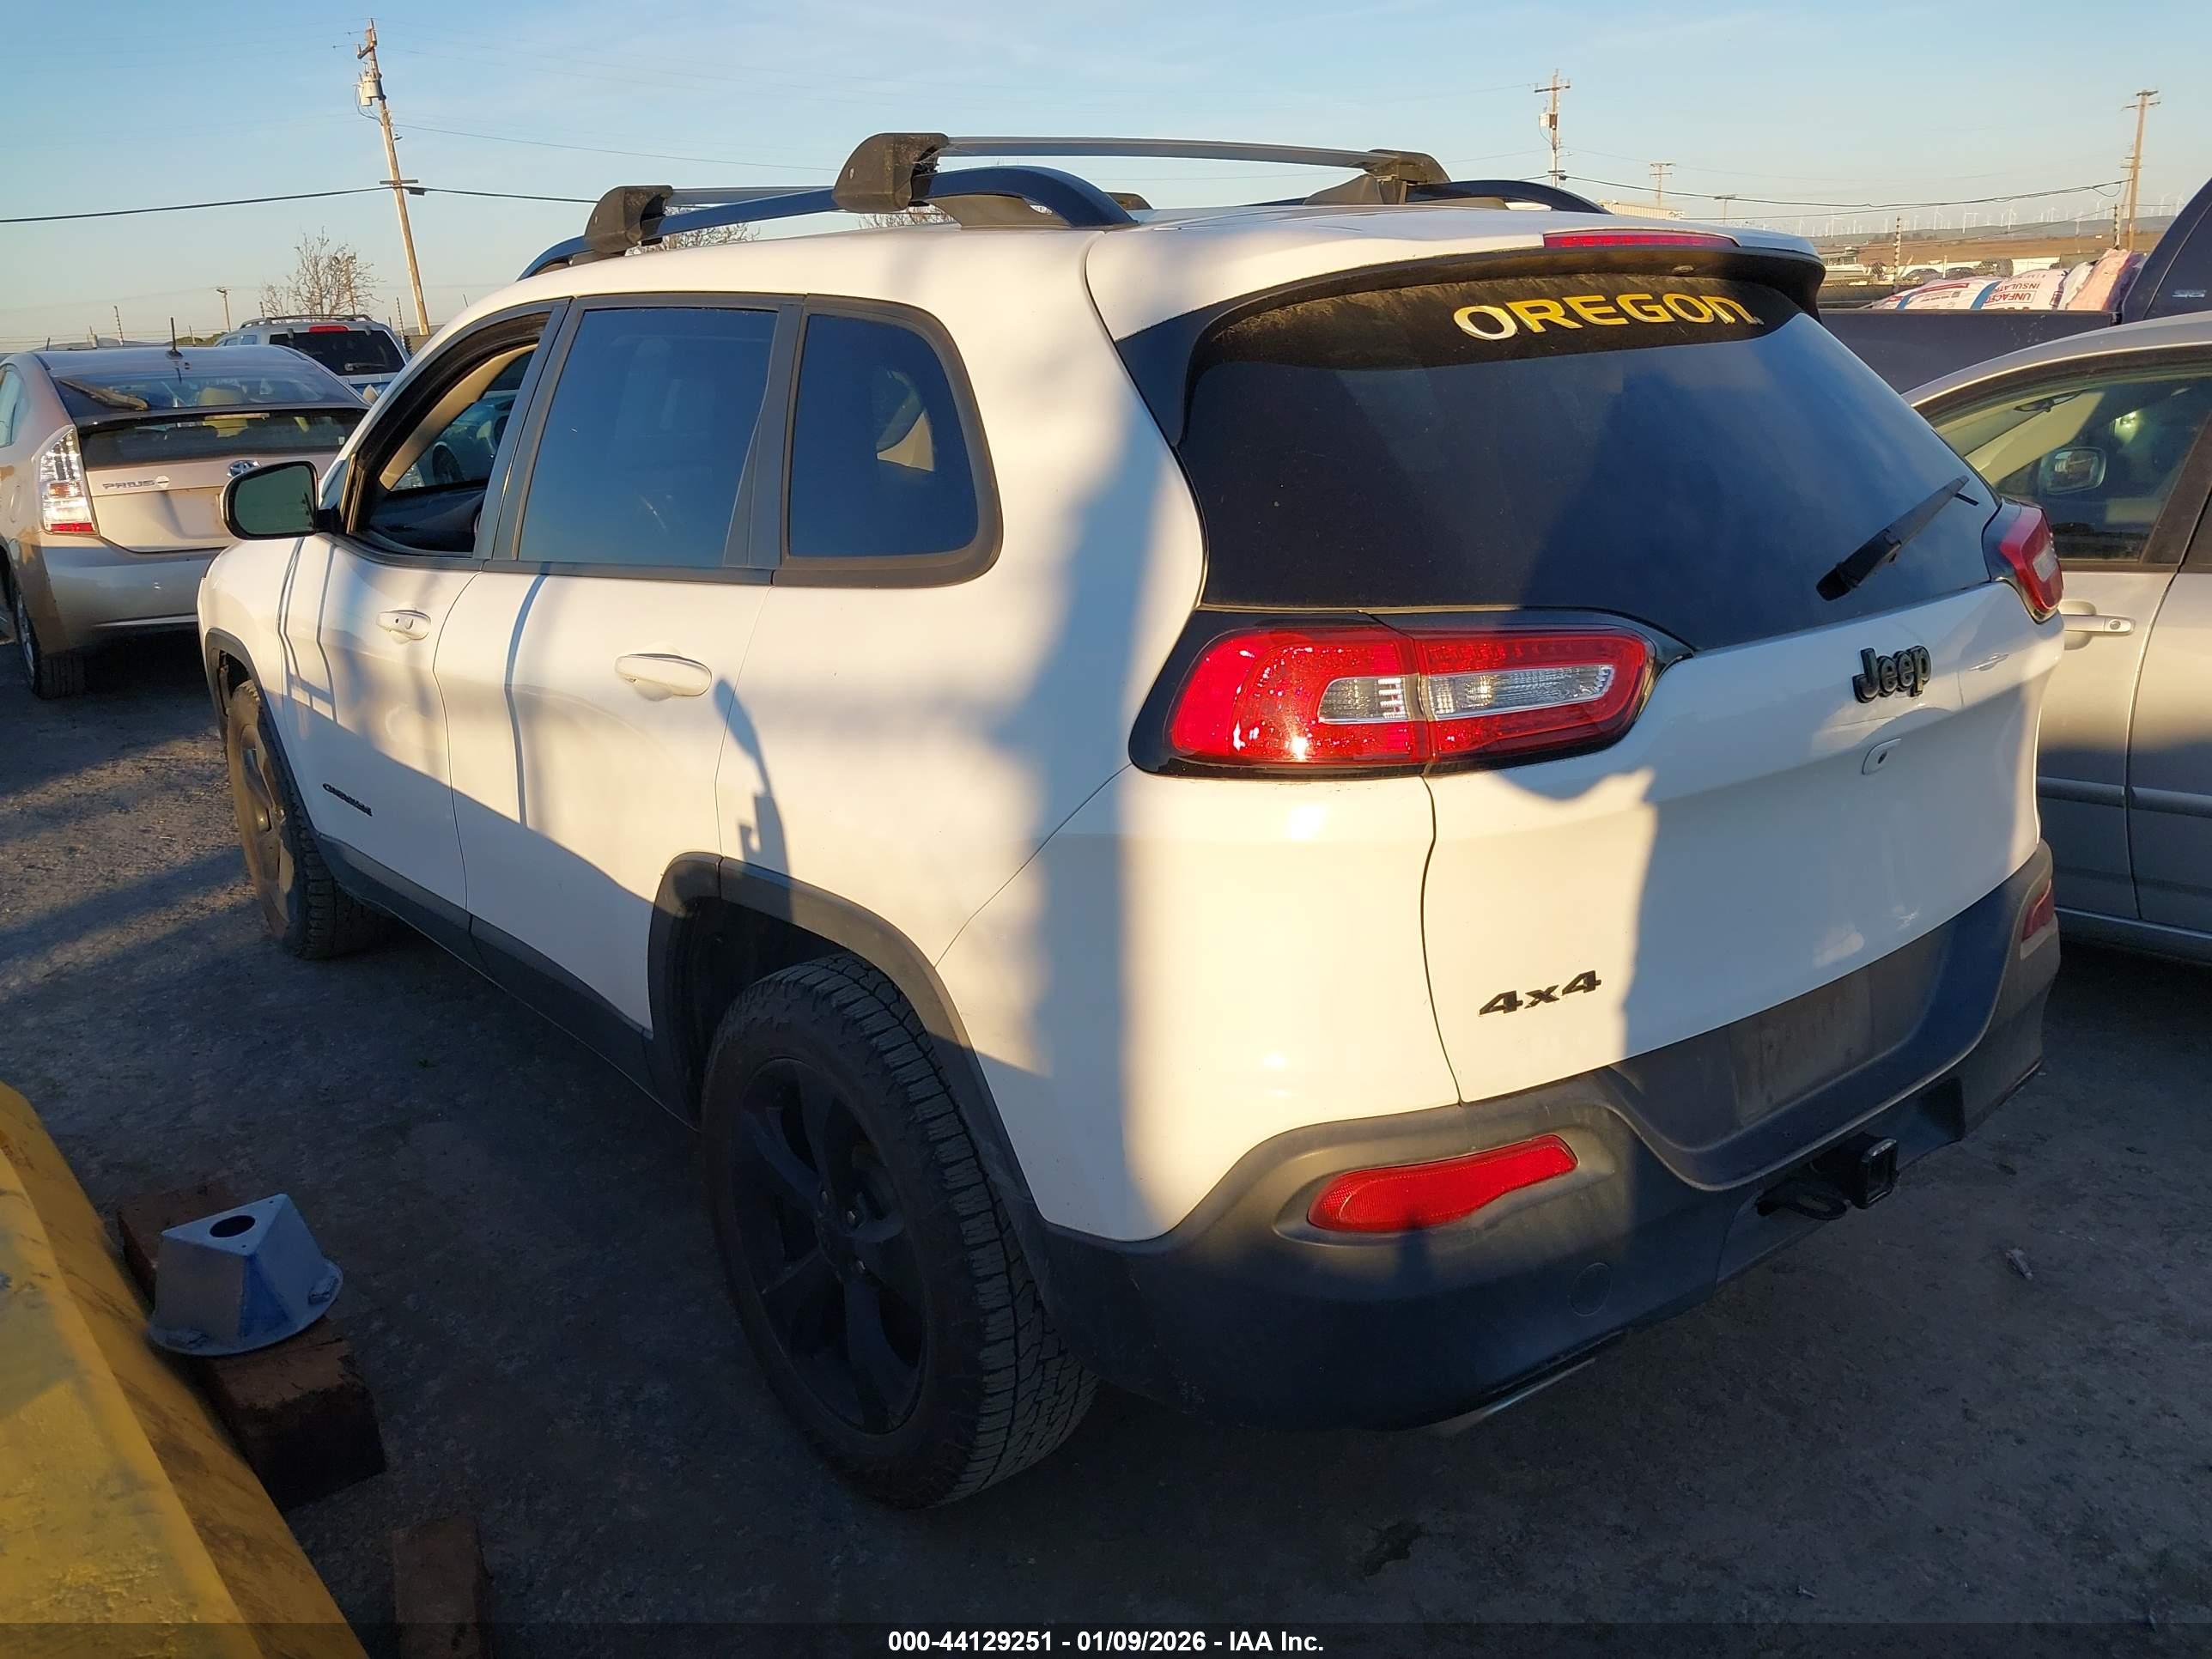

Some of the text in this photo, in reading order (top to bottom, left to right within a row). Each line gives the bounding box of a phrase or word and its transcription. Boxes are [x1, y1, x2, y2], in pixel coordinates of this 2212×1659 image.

[1453, 293, 1765, 341] OREGON
[102, 479, 155, 489] PRIUS
[1852, 645, 1932, 704] Jeep
[1479, 969, 1603, 1017] 4x4
